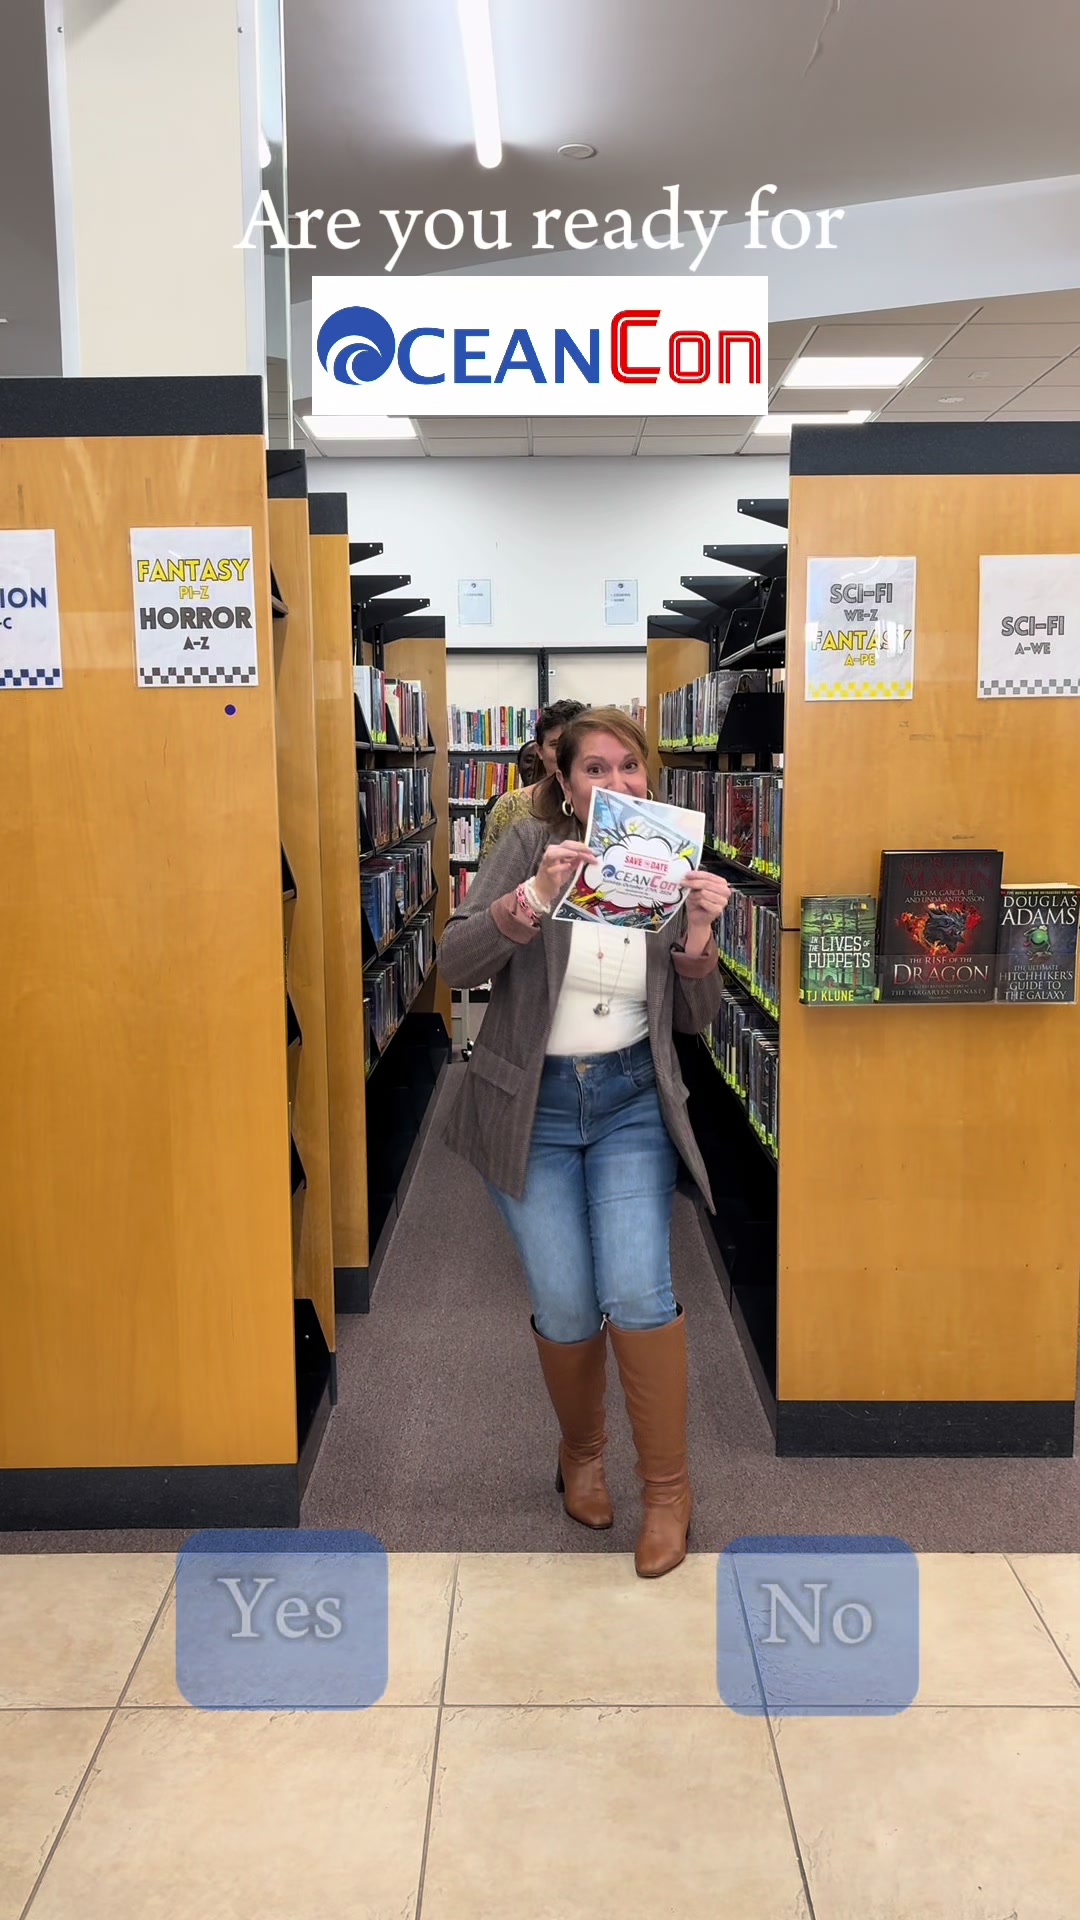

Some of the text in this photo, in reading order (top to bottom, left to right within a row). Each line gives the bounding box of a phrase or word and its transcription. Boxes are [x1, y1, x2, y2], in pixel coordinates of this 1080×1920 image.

[137, 558, 250, 582] FANTASY
[179, 586, 209, 599] PI-Z
[830, 583, 893, 604] SCI-FI
[139, 606, 252, 630] HORROR
[844, 609, 878, 622] WE-Z
[1001, 615, 1065, 637] SCI-FI
[183, 637, 210, 650] A-Z
[1015, 642, 1050, 655] A-WE
[844, 654, 876, 666] A-PE
[624, 856, 642, 867] SAVE
[651, 862, 669, 872] DATE
[1003, 895, 1078, 908] DOUGLAS
[1001, 908, 1076, 925] ADAMS
[811, 936, 819, 944] IN
[821, 936, 862, 952] LIVES
[808, 953, 870, 968] PUPPETS
[925, 956, 946, 964] RISE
[893, 964, 988, 985] DRAGON
[1000, 971, 1073, 981] HITCHHIKER'S
[1009, 981, 1061, 990] GUIDE TO
[806, 990, 854, 1001] TJ KLUNE
[1004, 991, 1067, 1000] THE GALAXY
